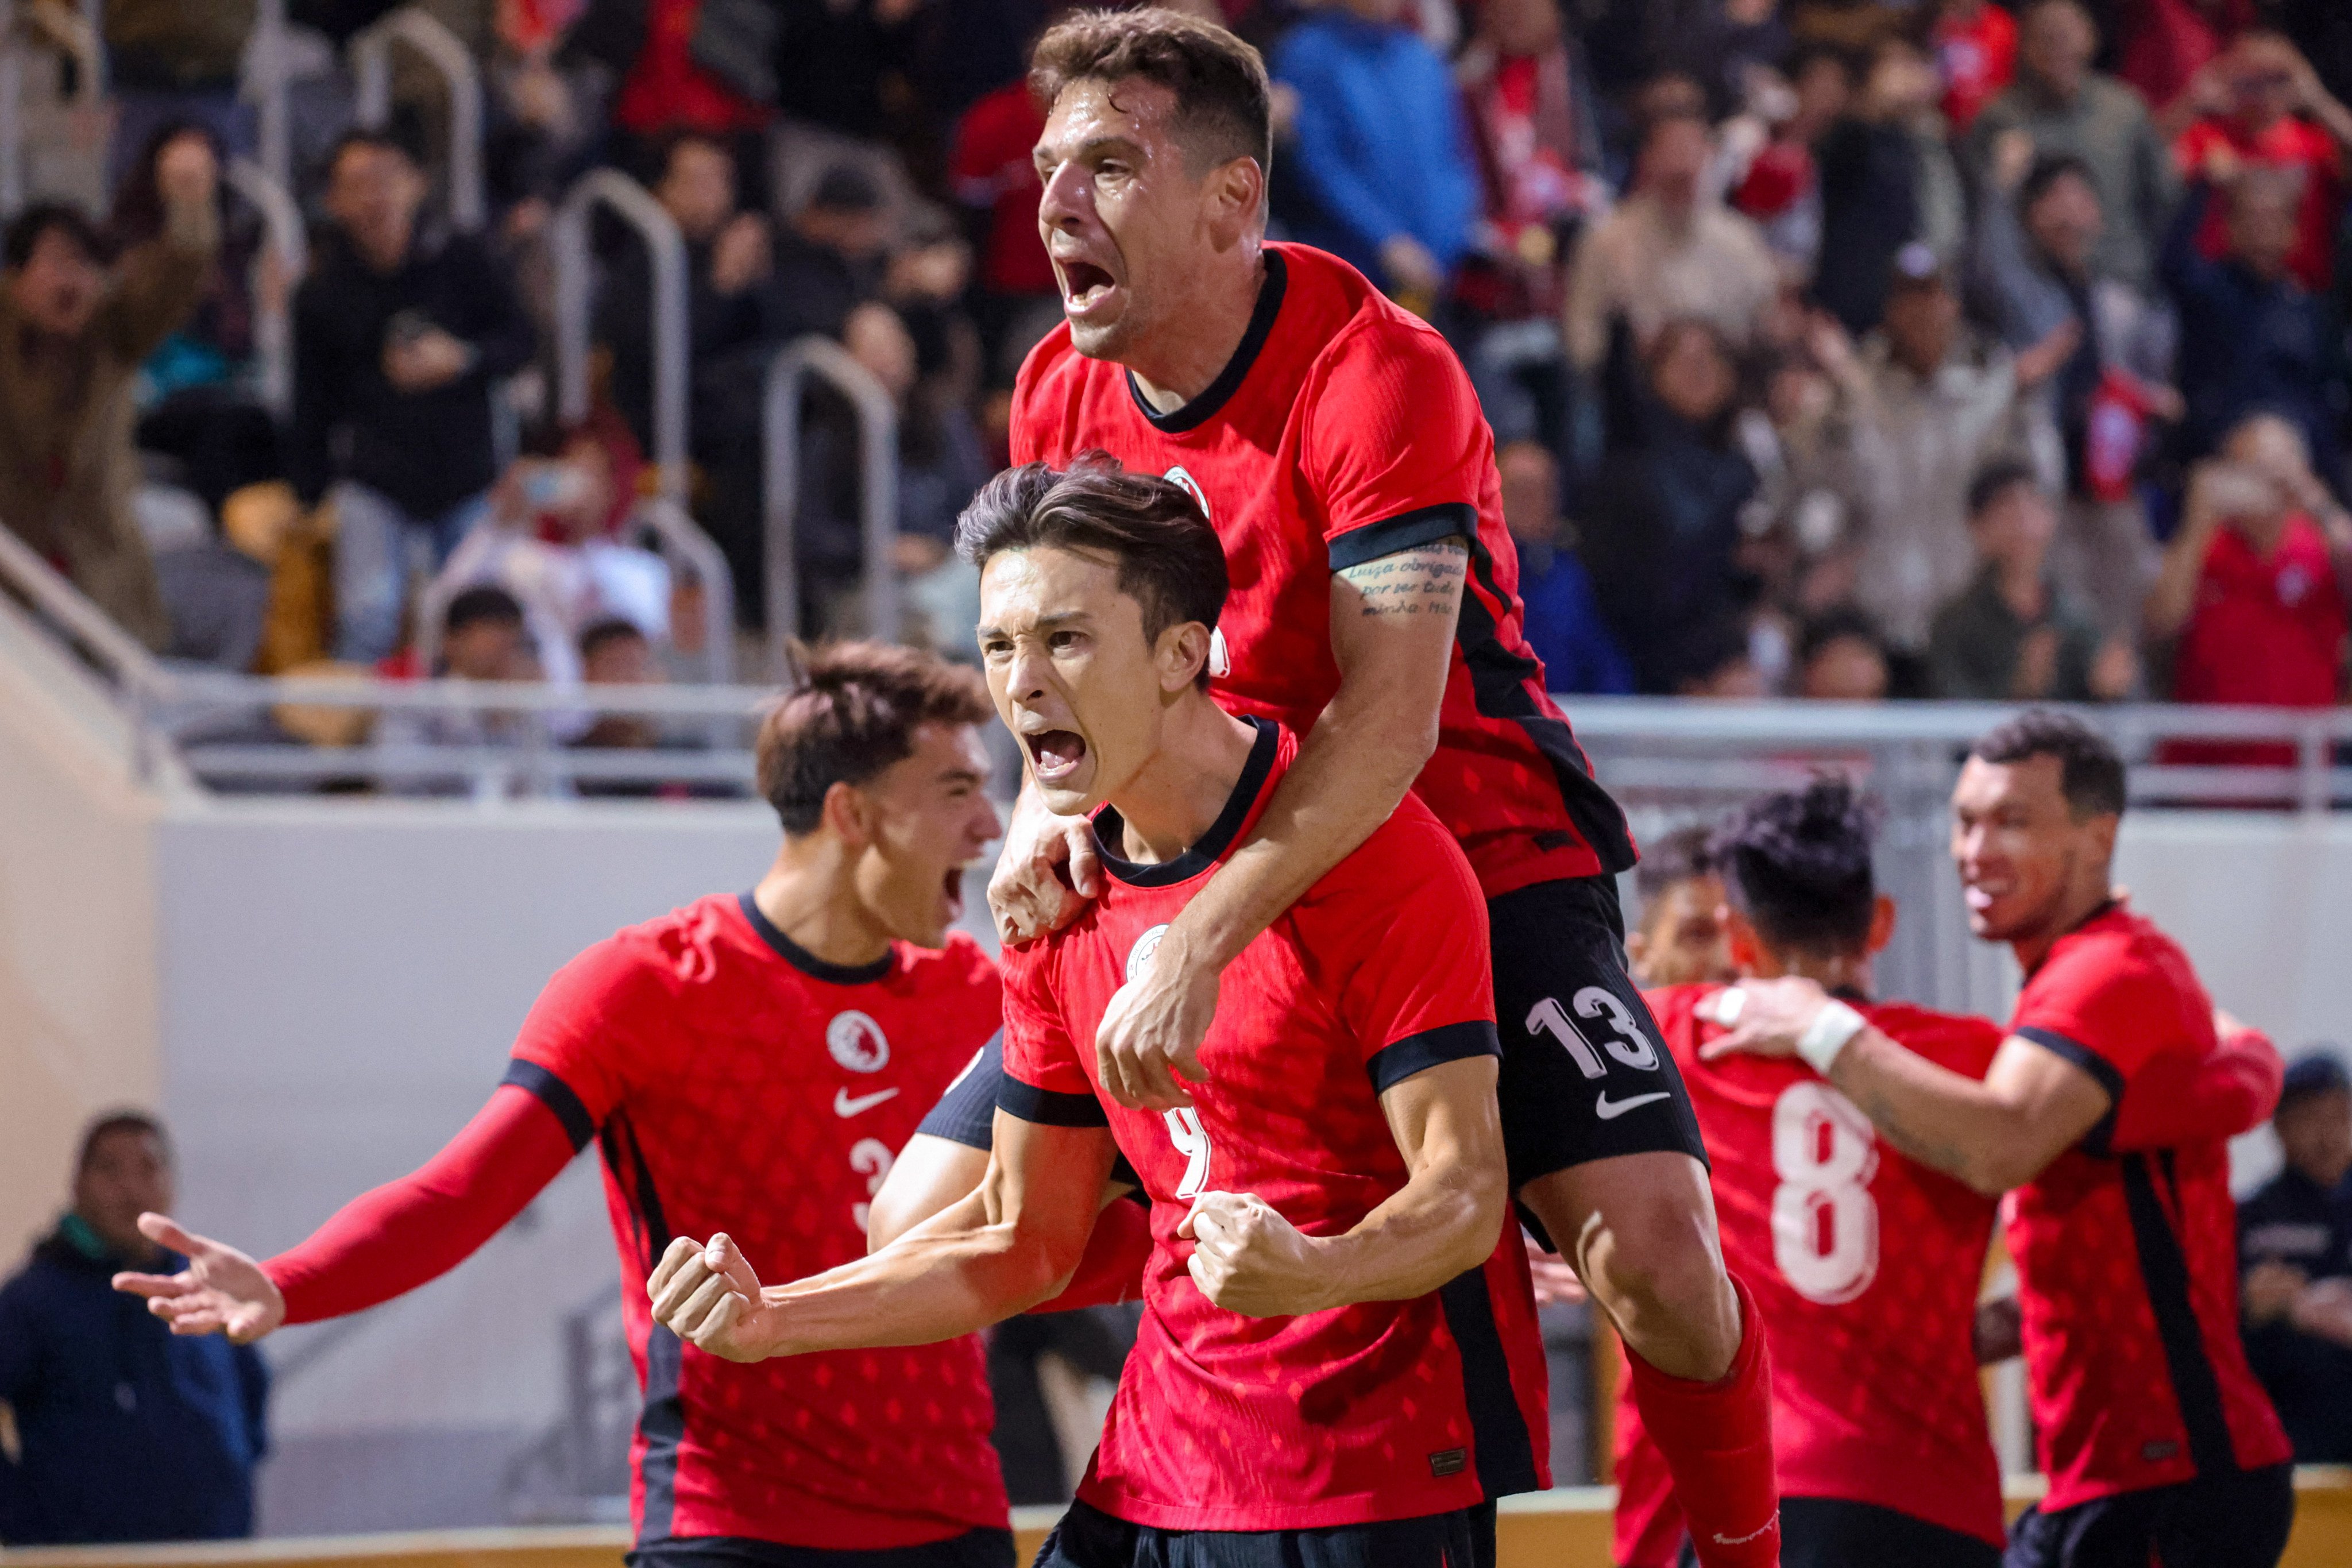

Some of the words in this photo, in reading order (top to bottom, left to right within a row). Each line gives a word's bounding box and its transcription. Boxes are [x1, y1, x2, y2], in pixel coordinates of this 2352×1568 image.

[1360, 585, 1391, 601] por
[1525, 986, 1659, 1079] 13
[1771, 1079, 1880, 1305] 8
